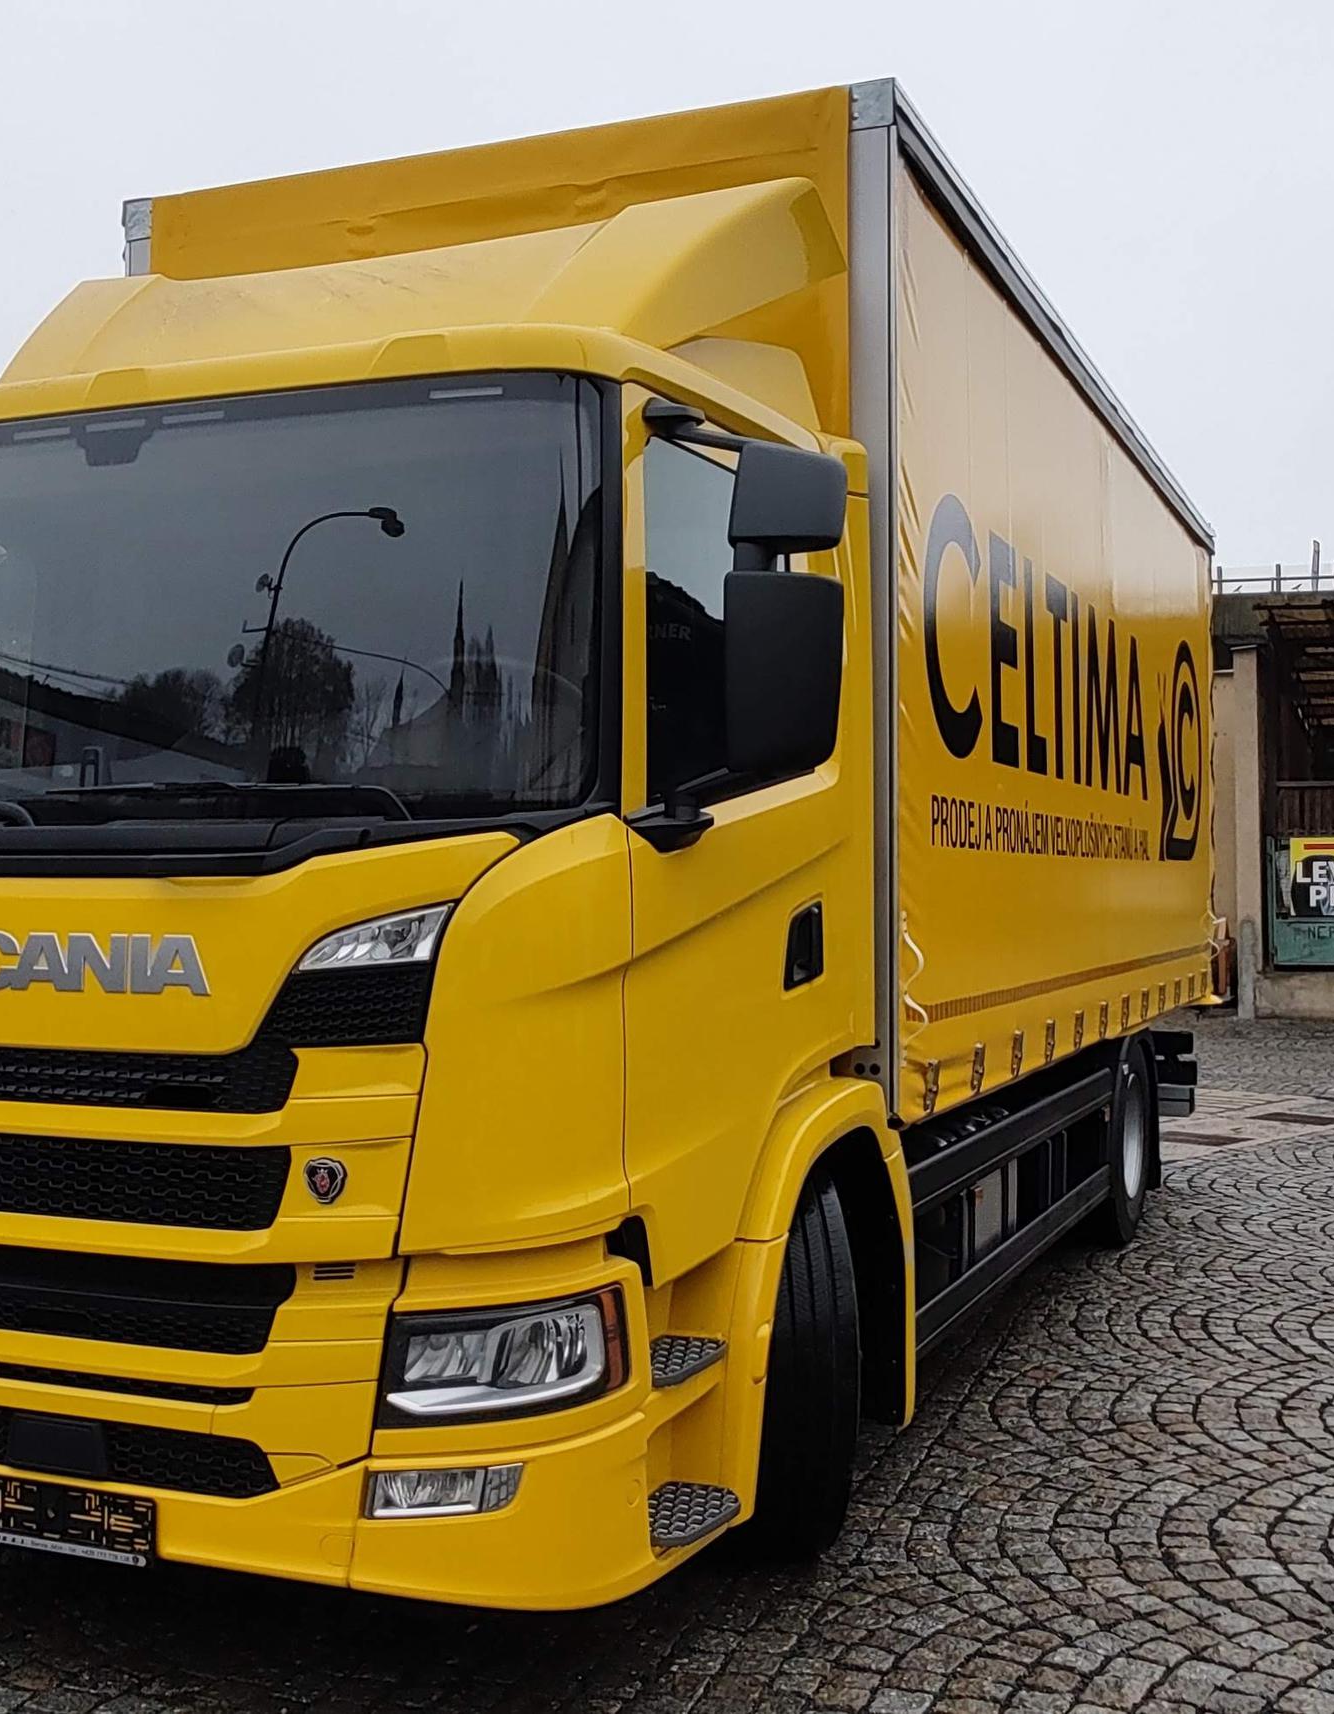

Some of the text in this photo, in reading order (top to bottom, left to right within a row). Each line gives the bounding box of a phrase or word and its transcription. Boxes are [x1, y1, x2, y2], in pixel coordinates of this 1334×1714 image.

[923, 493, 1148, 801] CELTIMA
[931, 794, 981, 851] PRODEJ
[984, 804, 993, 852] A
[995, 800, 1049, 856] PRONÁJEM
